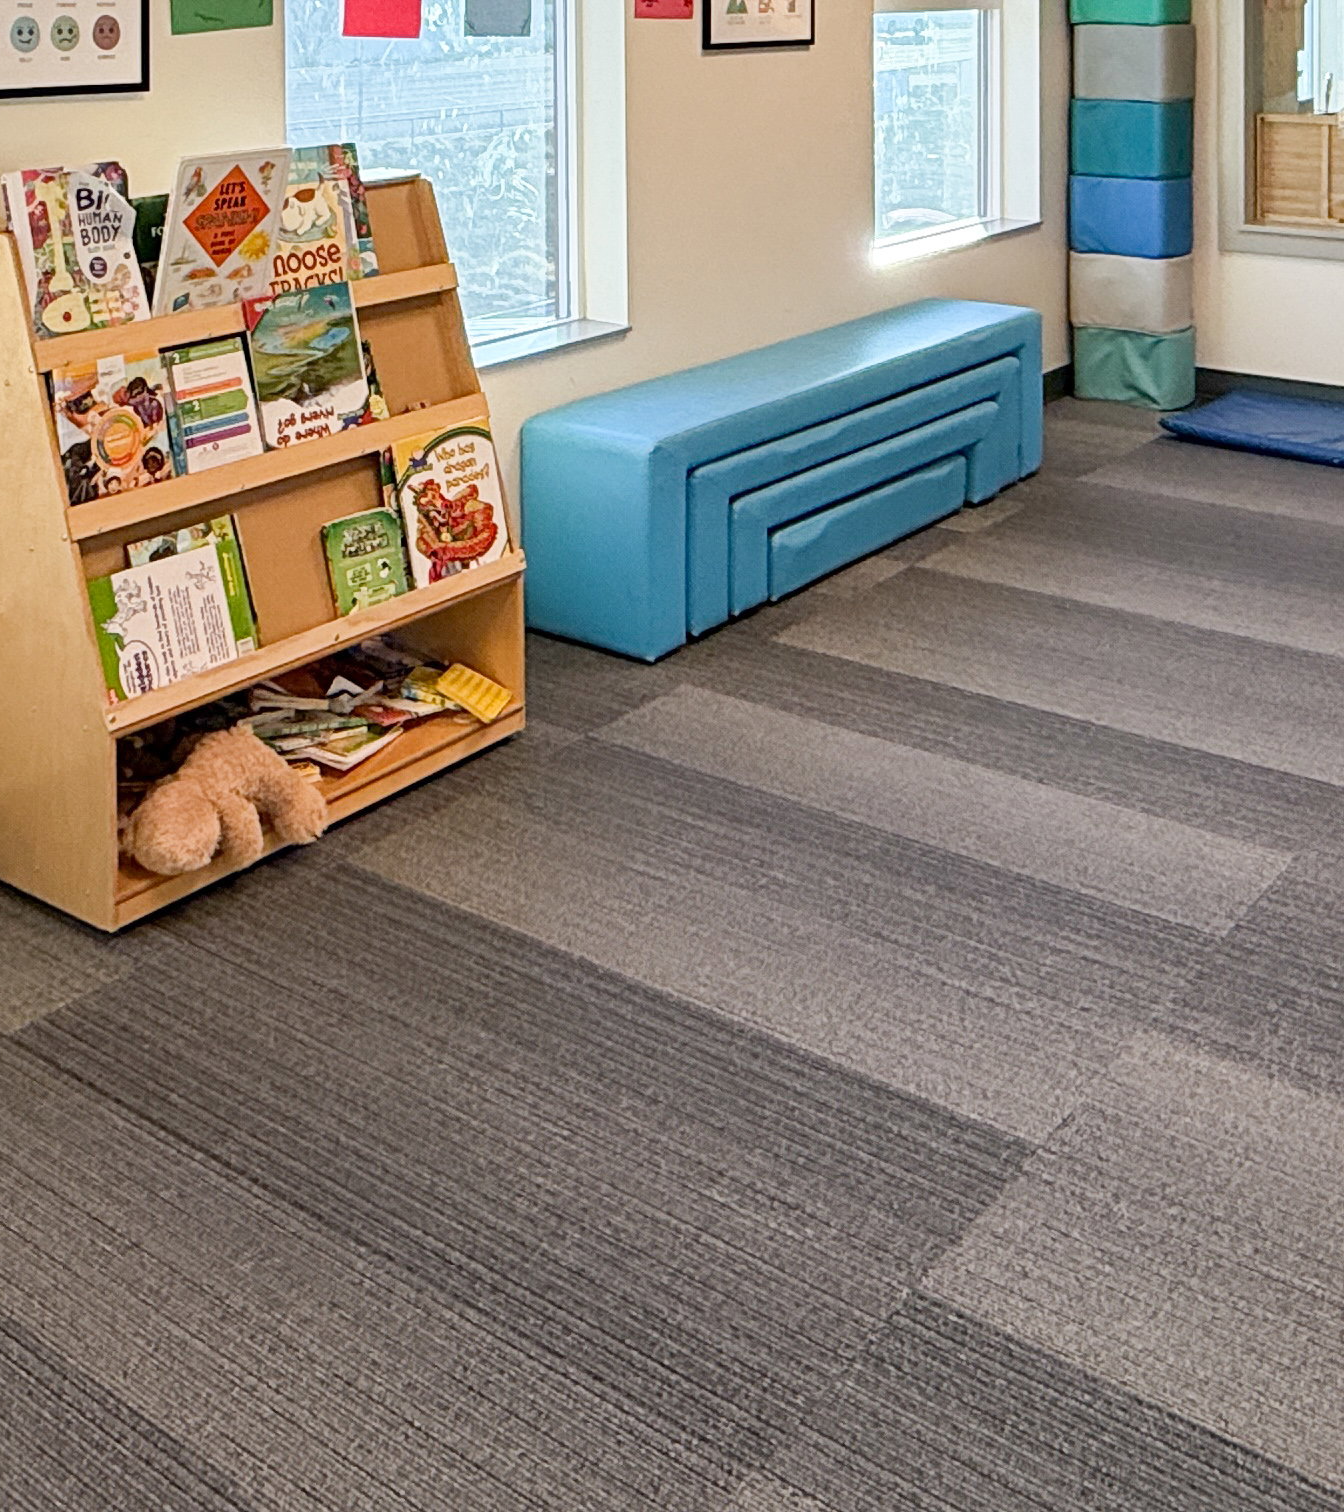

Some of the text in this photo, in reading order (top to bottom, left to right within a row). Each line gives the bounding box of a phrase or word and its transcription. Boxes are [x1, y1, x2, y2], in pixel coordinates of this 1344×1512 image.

[219, 181, 246, 196] LET'S
[214, 196, 247, 211] SPEAK
[78, 211, 123, 227] HUMAN
[80, 225, 121, 246] BODY
